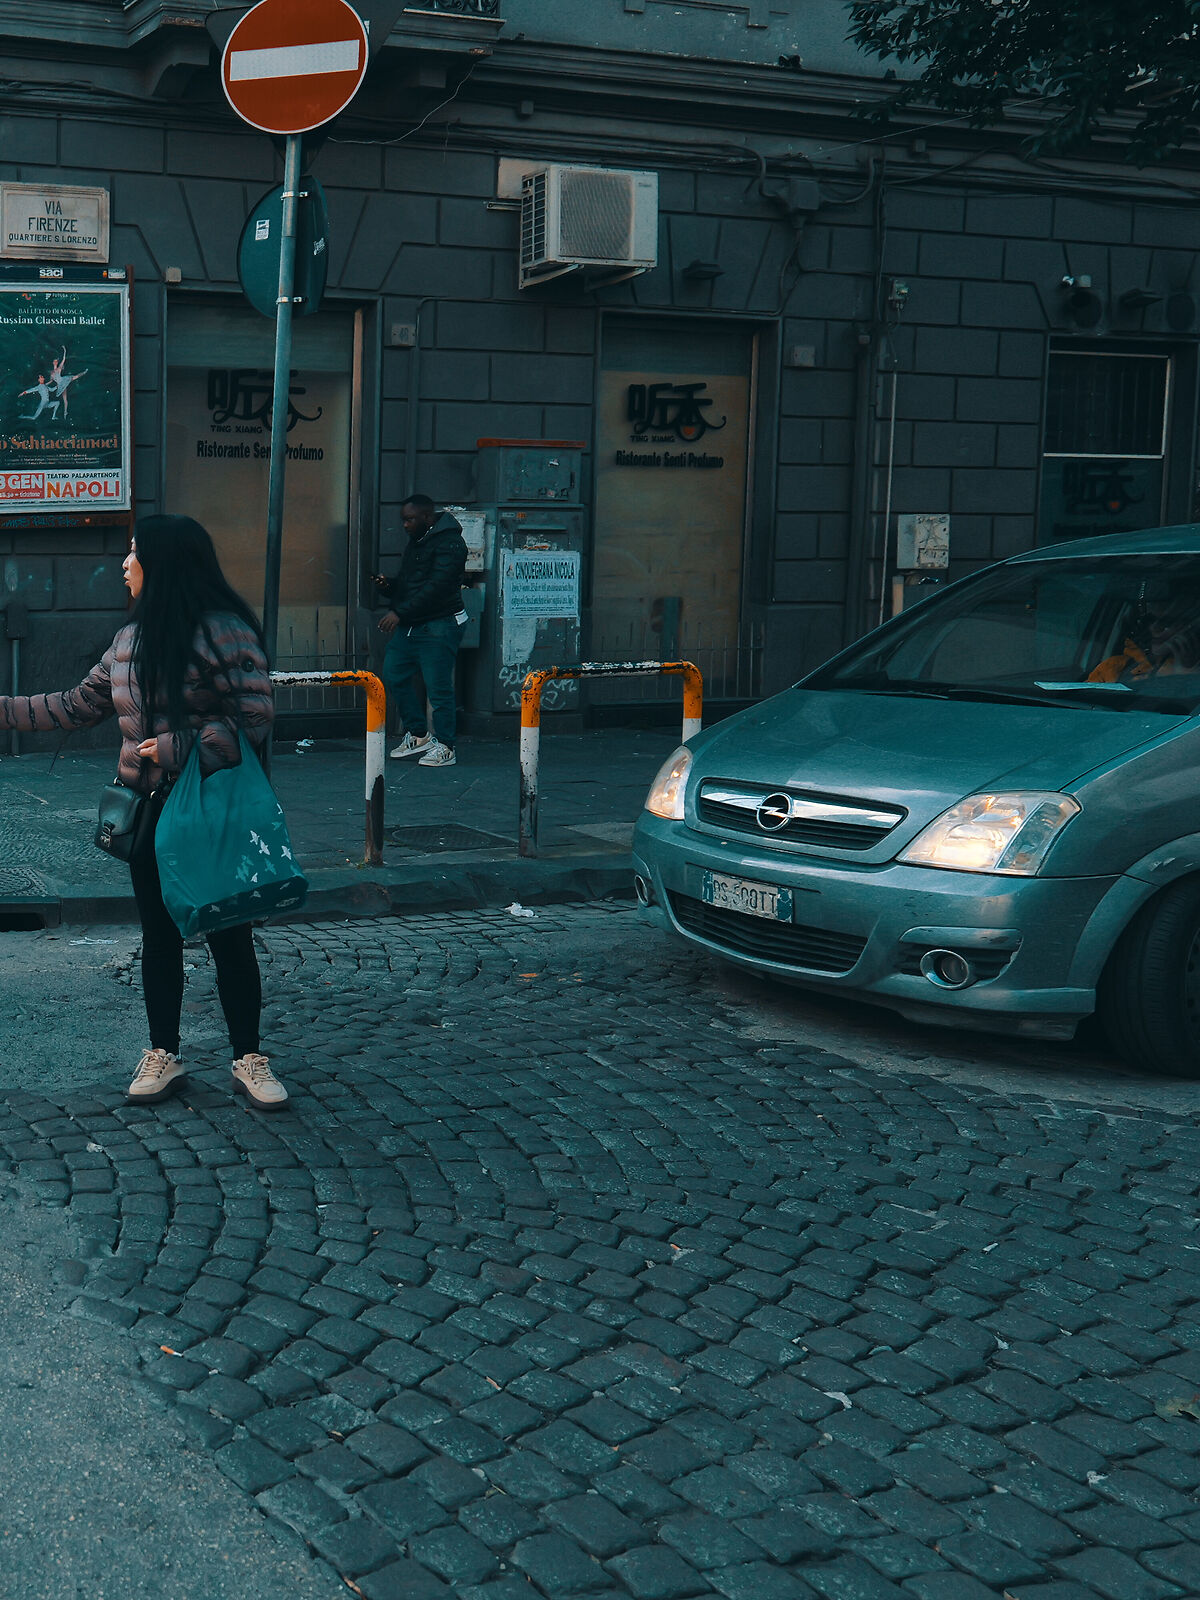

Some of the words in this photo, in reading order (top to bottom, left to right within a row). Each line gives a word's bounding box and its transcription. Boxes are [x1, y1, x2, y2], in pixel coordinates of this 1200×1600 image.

[44, 200, 63, 215] VIA
[28, 216, 78, 233] FIRENZE
[8, 233, 52, 243] QUARTIERE
[61, 235, 97, 245] LORENZO
[35, 315, 76, 325] Classical
[79, 316, 106, 325] Ballet
[210, 424, 232, 433] TING
[234, 425, 263, 434] XIANG
[10, 434, 118, 450] Schiaccianoci
[629, 434, 649, 443] TING
[196, 440, 251, 459] Ristorante
[252, 441, 273, 459] Sen
[615, 449, 662, 466] Ristorante
[664, 451, 687, 468] Senti
[688, 452, 724, 469] Profumo
[7, 473, 43, 489] GEN
[46, 472, 70, 480] TEATRO
[46, 480, 120, 499] NAPOLI
[515, 561, 554, 583] CINQUEGRANA
[554, 561, 575, 580] NICOLA
